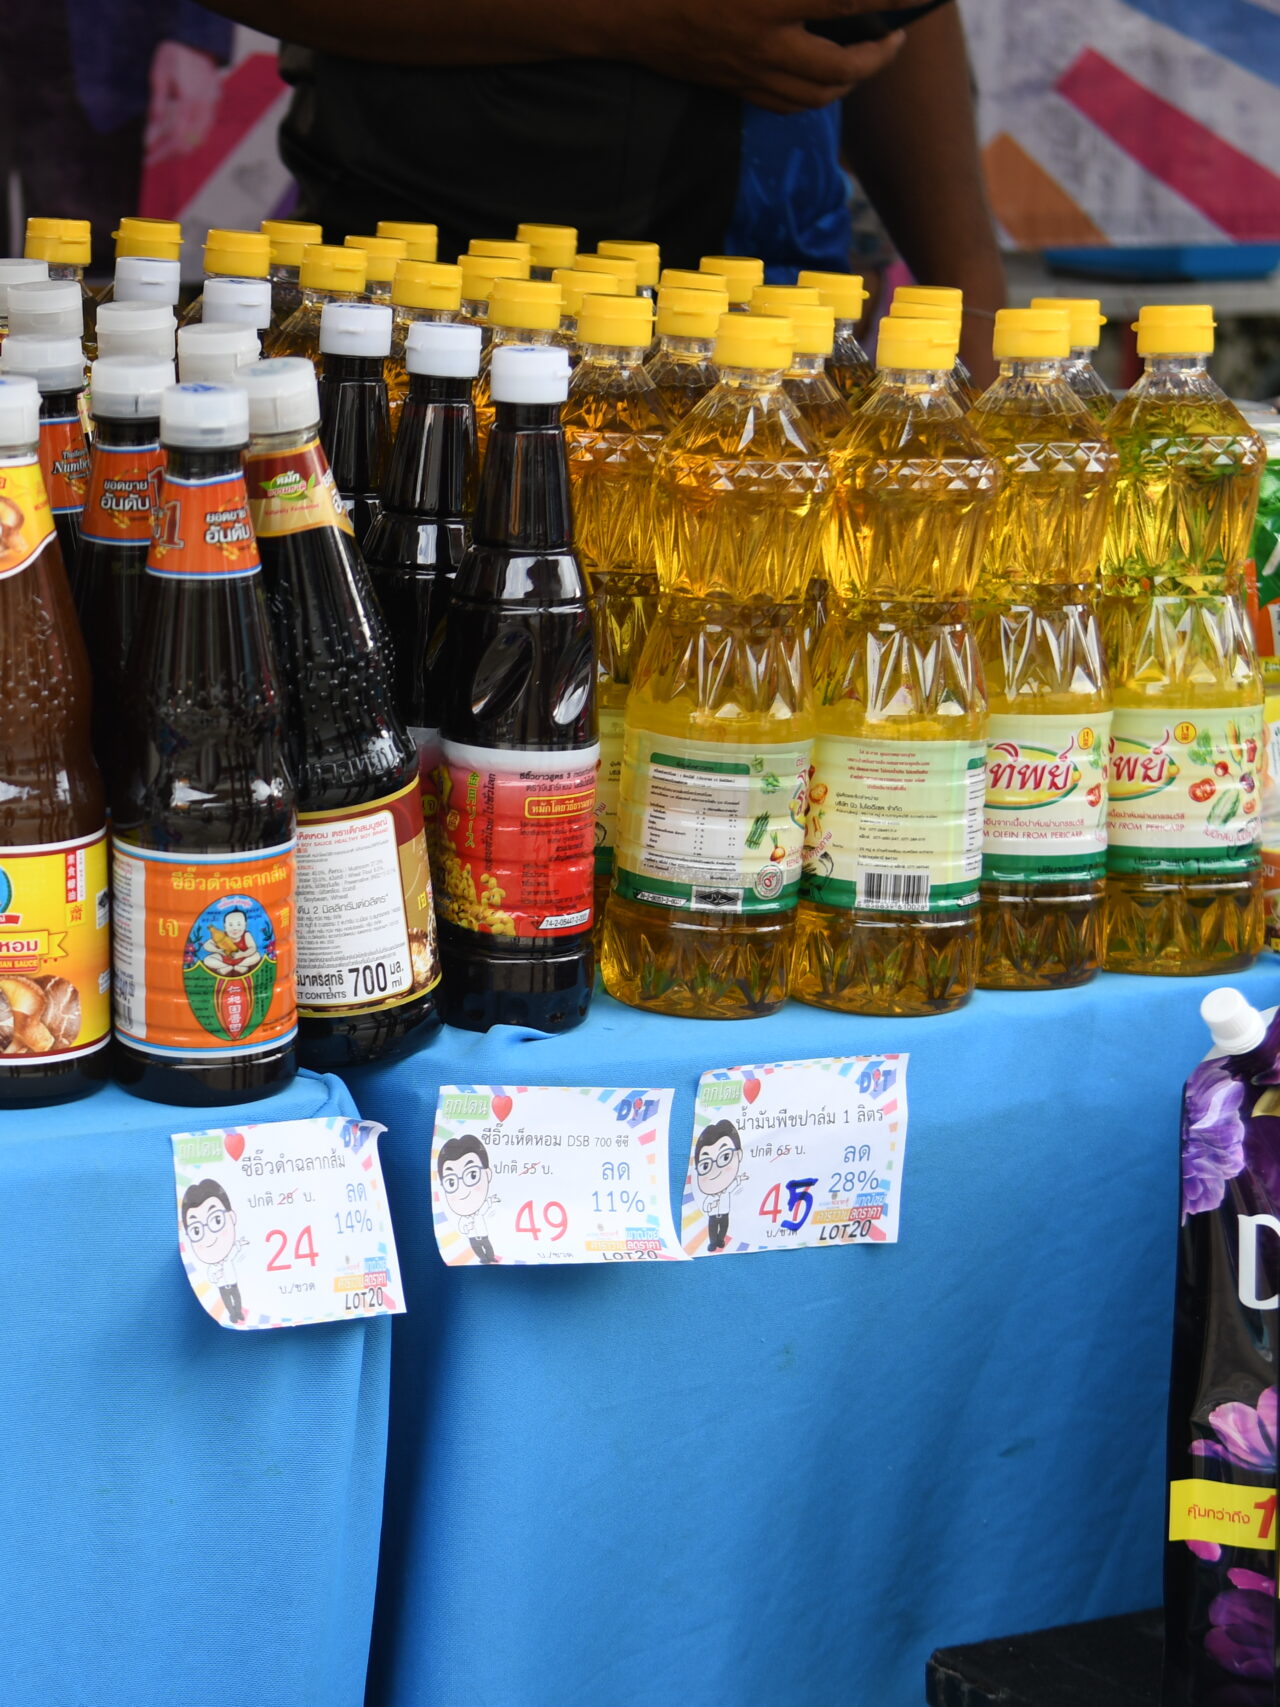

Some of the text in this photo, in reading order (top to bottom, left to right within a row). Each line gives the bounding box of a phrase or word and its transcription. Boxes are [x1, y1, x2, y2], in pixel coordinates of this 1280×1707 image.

[985, 735, 1075, 791] ทิพย์
[1022, 831, 1048, 839] FROM
[312, 905, 319, 914] 2
[14, 959, 39, 968] SAUCE
[347, 961, 388, 997] 700
[305, 991, 347, 1000] CONTENTS
[736, 1103, 885, 1131] น้ำมันพืชปาล์ม 1 ลิตร
[481, 1123, 562, 1148] ซีอิ๊วเห็ดหอม
[567, 1135, 590, 1147] DSB
[594, 1136, 612, 1148] 700
[750, 1143, 773, 1158] ปกติ
[843, 1143, 871, 1164] ลด
[241, 1147, 347, 1178] ซีอิ๊วดำฉลากส้ม
[494, 1160, 518, 1176] ปกติ
[601, 1161, 631, 1181] ลด
[345, 1182, 368, 1203] ลด
[828, 1169, 880, 1194] 28%
[247, 1191, 274, 1209] ปกติ
[591, 1190, 646, 1213] 11%
[334, 1210, 373, 1235] 14%
[515, 1200, 569, 1242] 49
[264, 1224, 319, 1272] 24
[1187, 1503, 1251, 1525] คุ้มกว่าถึง
